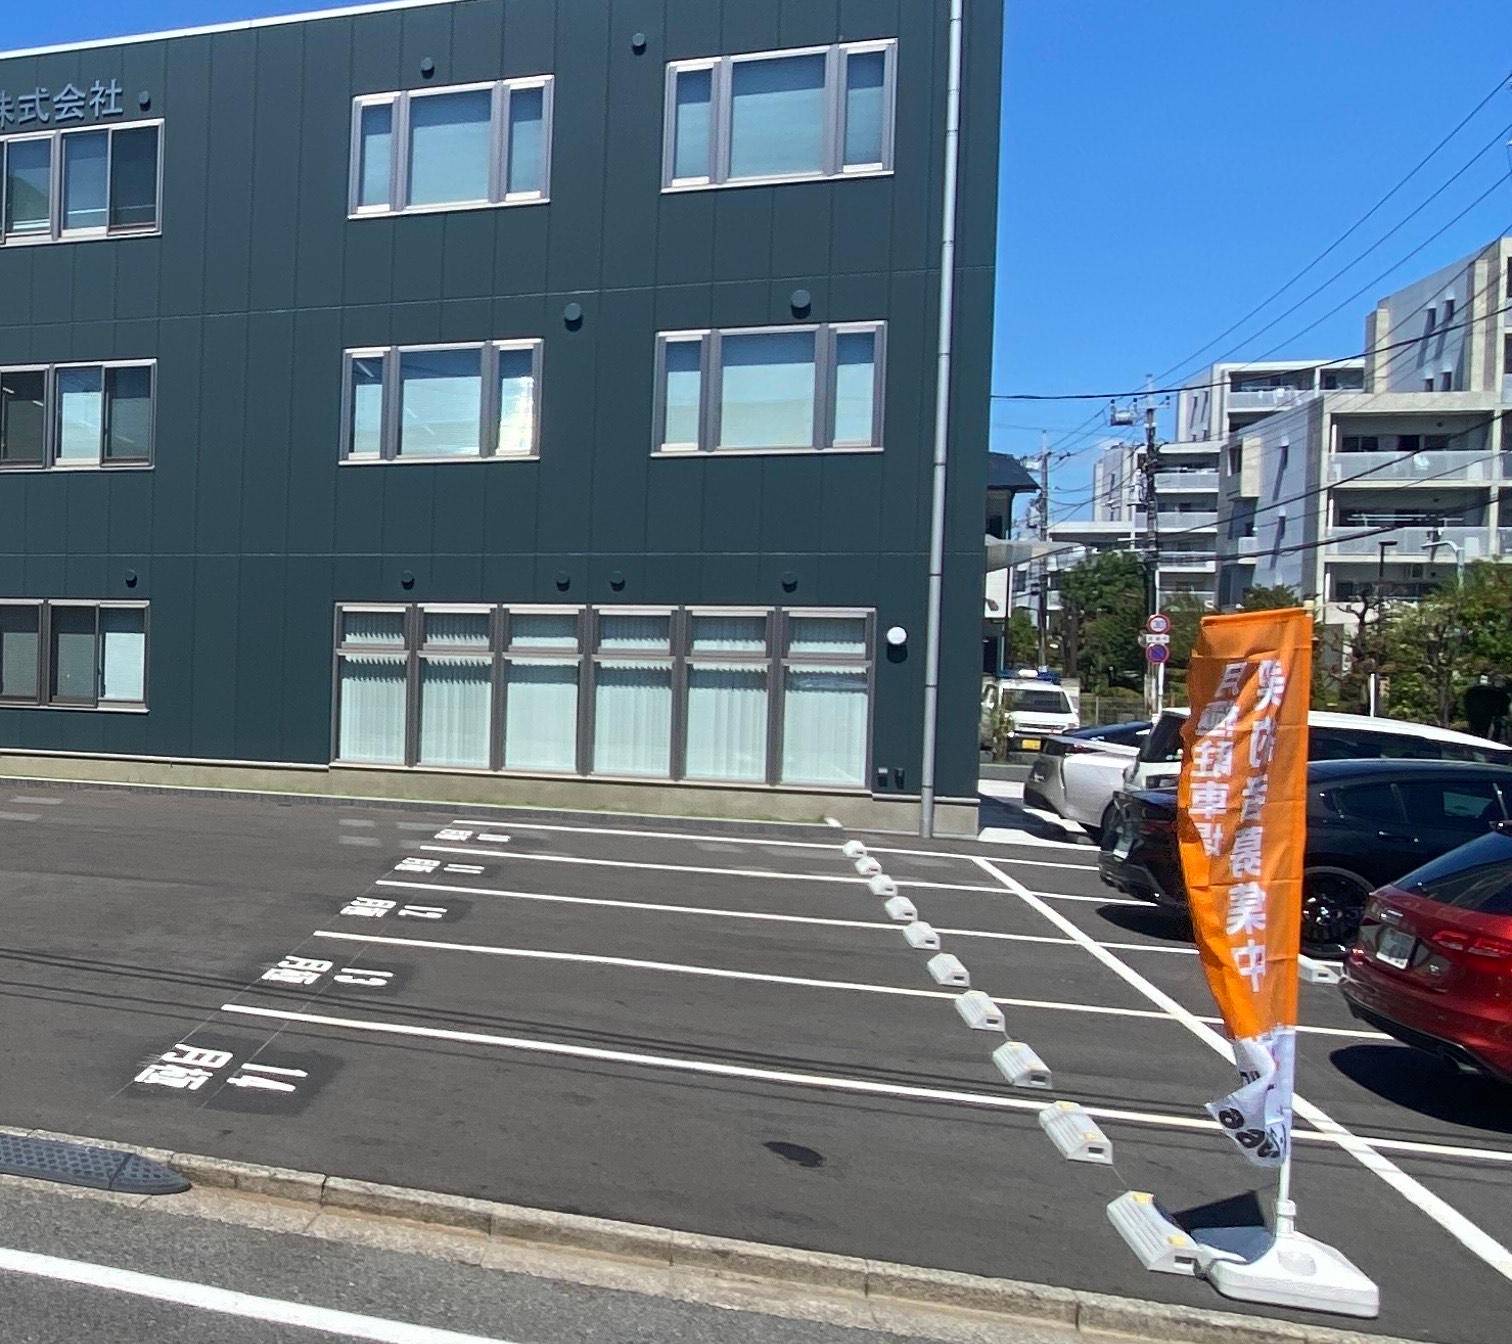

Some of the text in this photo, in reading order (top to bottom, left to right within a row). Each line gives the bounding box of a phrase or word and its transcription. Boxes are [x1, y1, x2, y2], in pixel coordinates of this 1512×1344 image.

[443, 863, 486, 874] 11
[397, 904, 449, 919] 12
[260, 954, 334, 985] 月極
[333, 967, 395, 986] 13
[133, 1042, 235, 1091] 月極
[226, 1062, 309, 1093] 14
